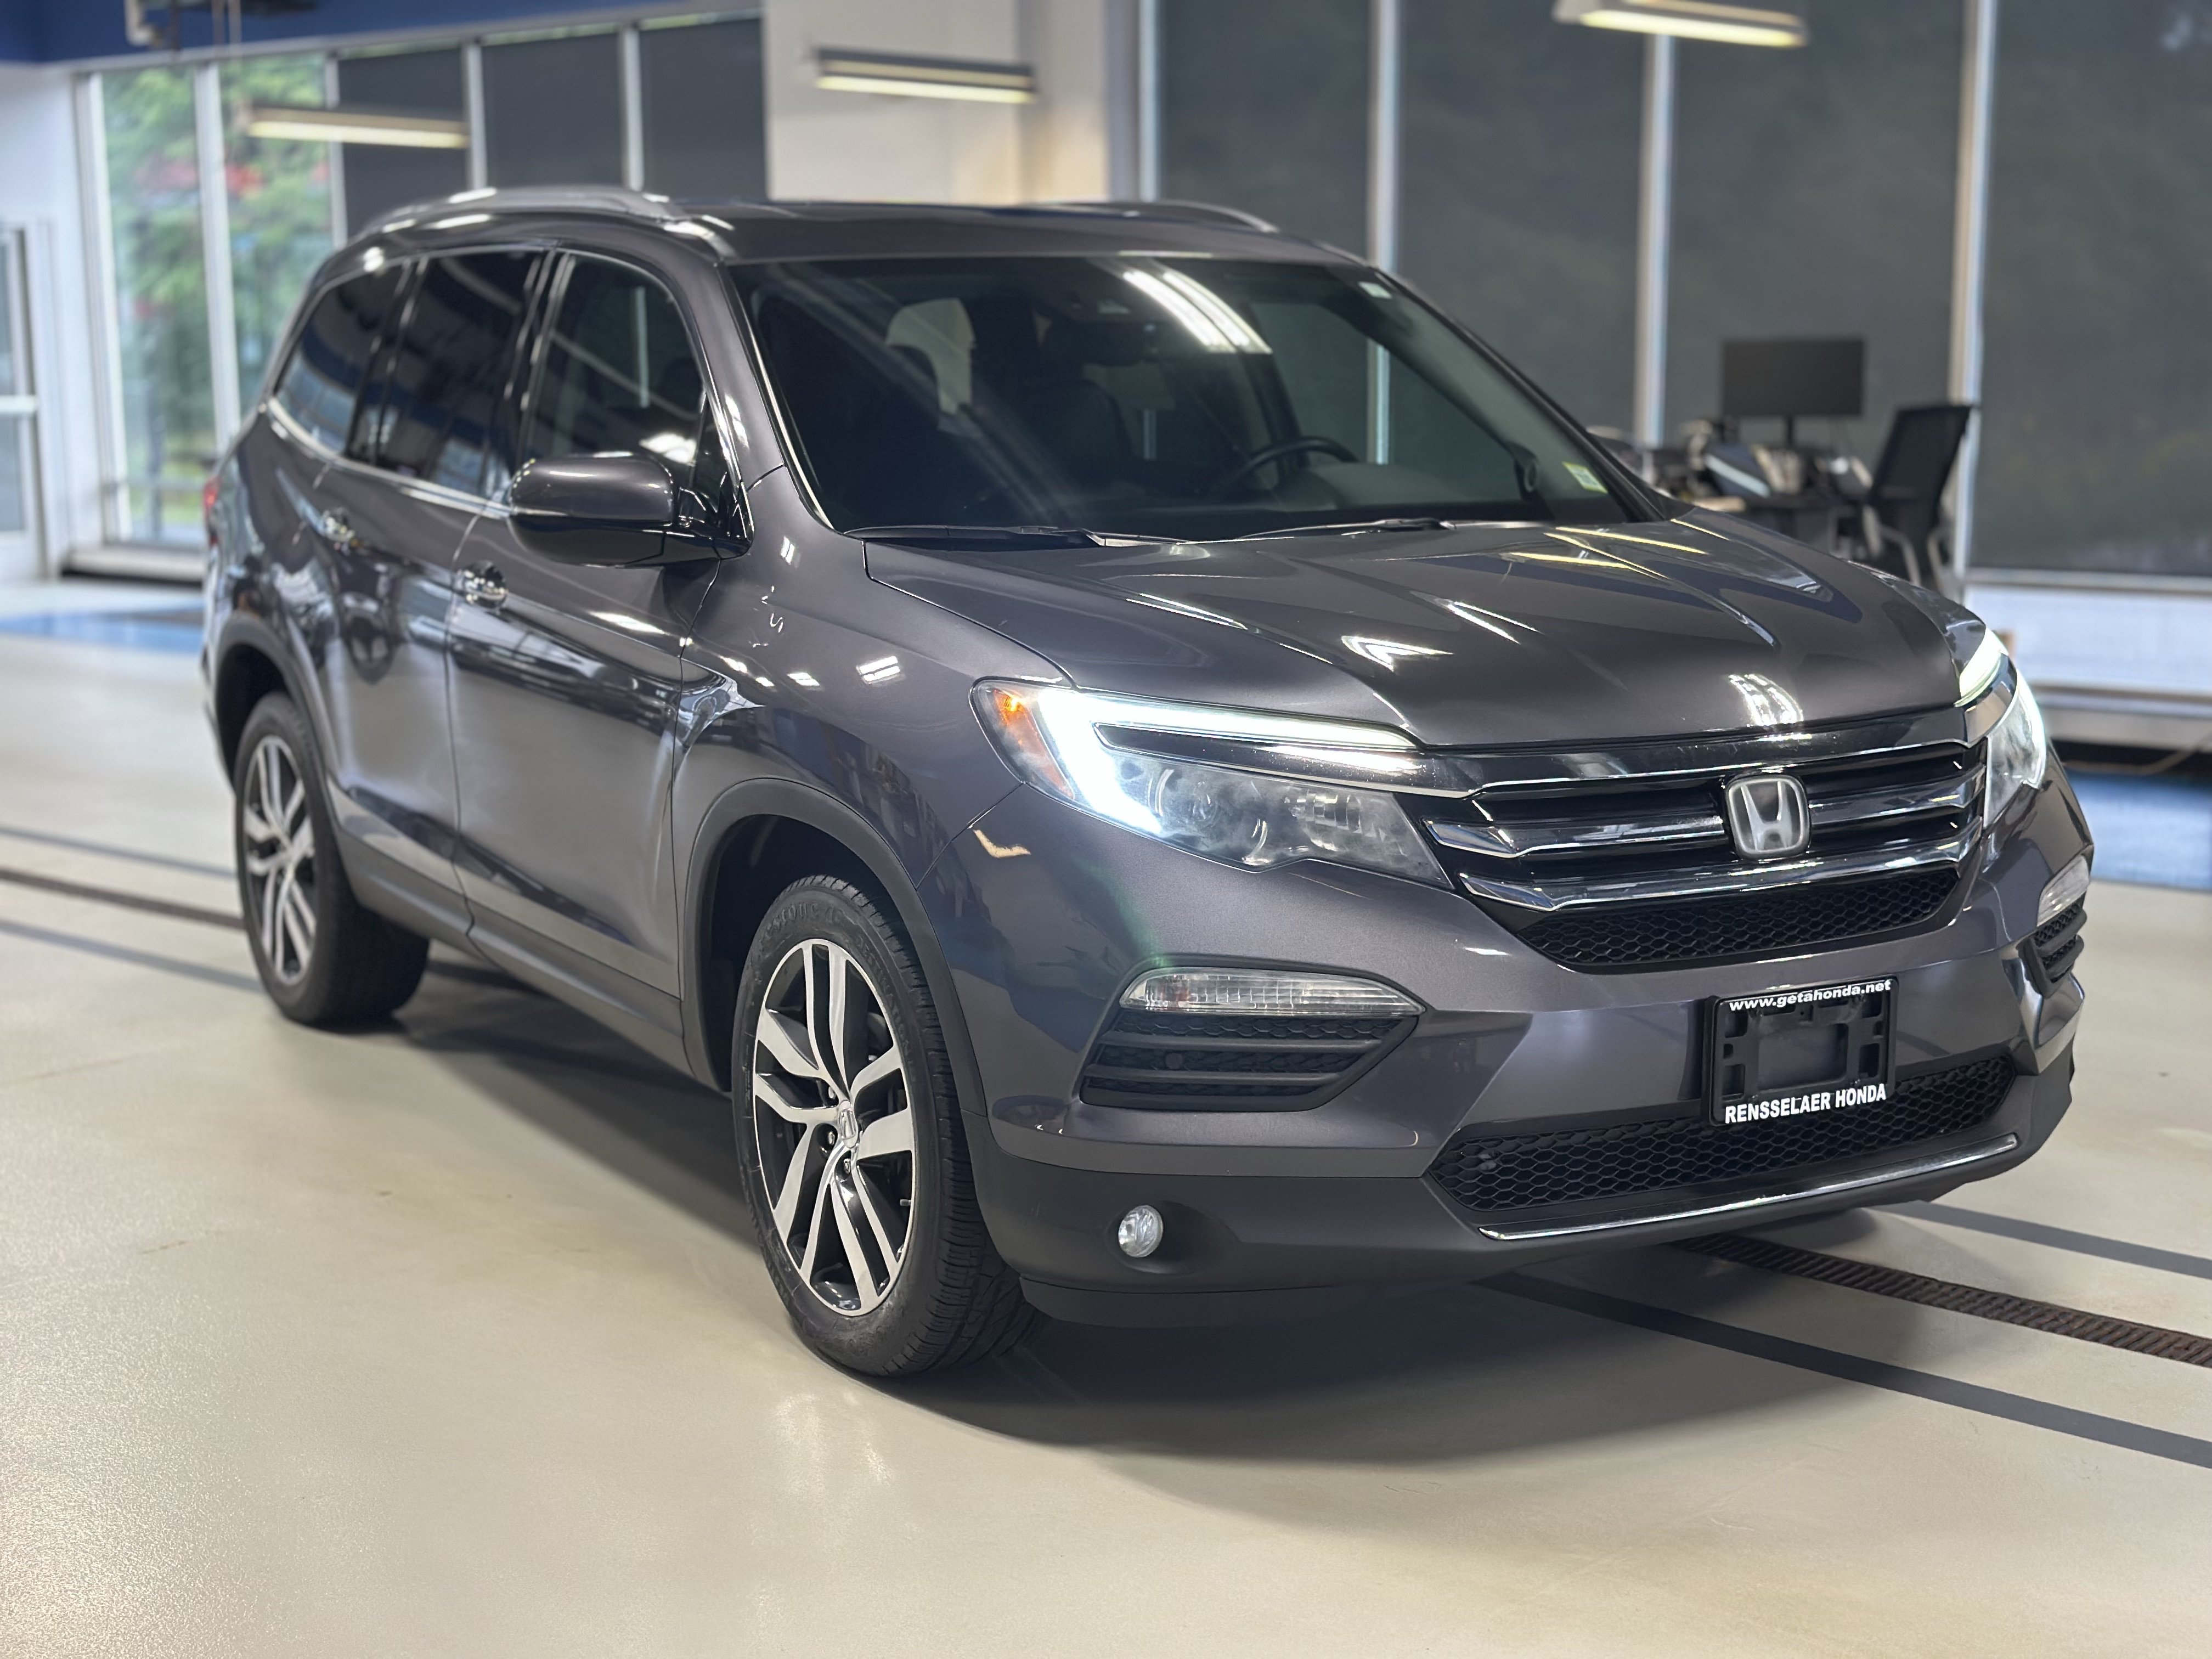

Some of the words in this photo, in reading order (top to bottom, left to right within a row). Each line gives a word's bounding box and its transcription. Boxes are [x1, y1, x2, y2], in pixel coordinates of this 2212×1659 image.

[1729, 980, 1891, 1011] www.getahonda.net
[1725, 1092, 1831, 1124] RENSSELAER
[1835, 1084, 1886, 1108] HONDA
